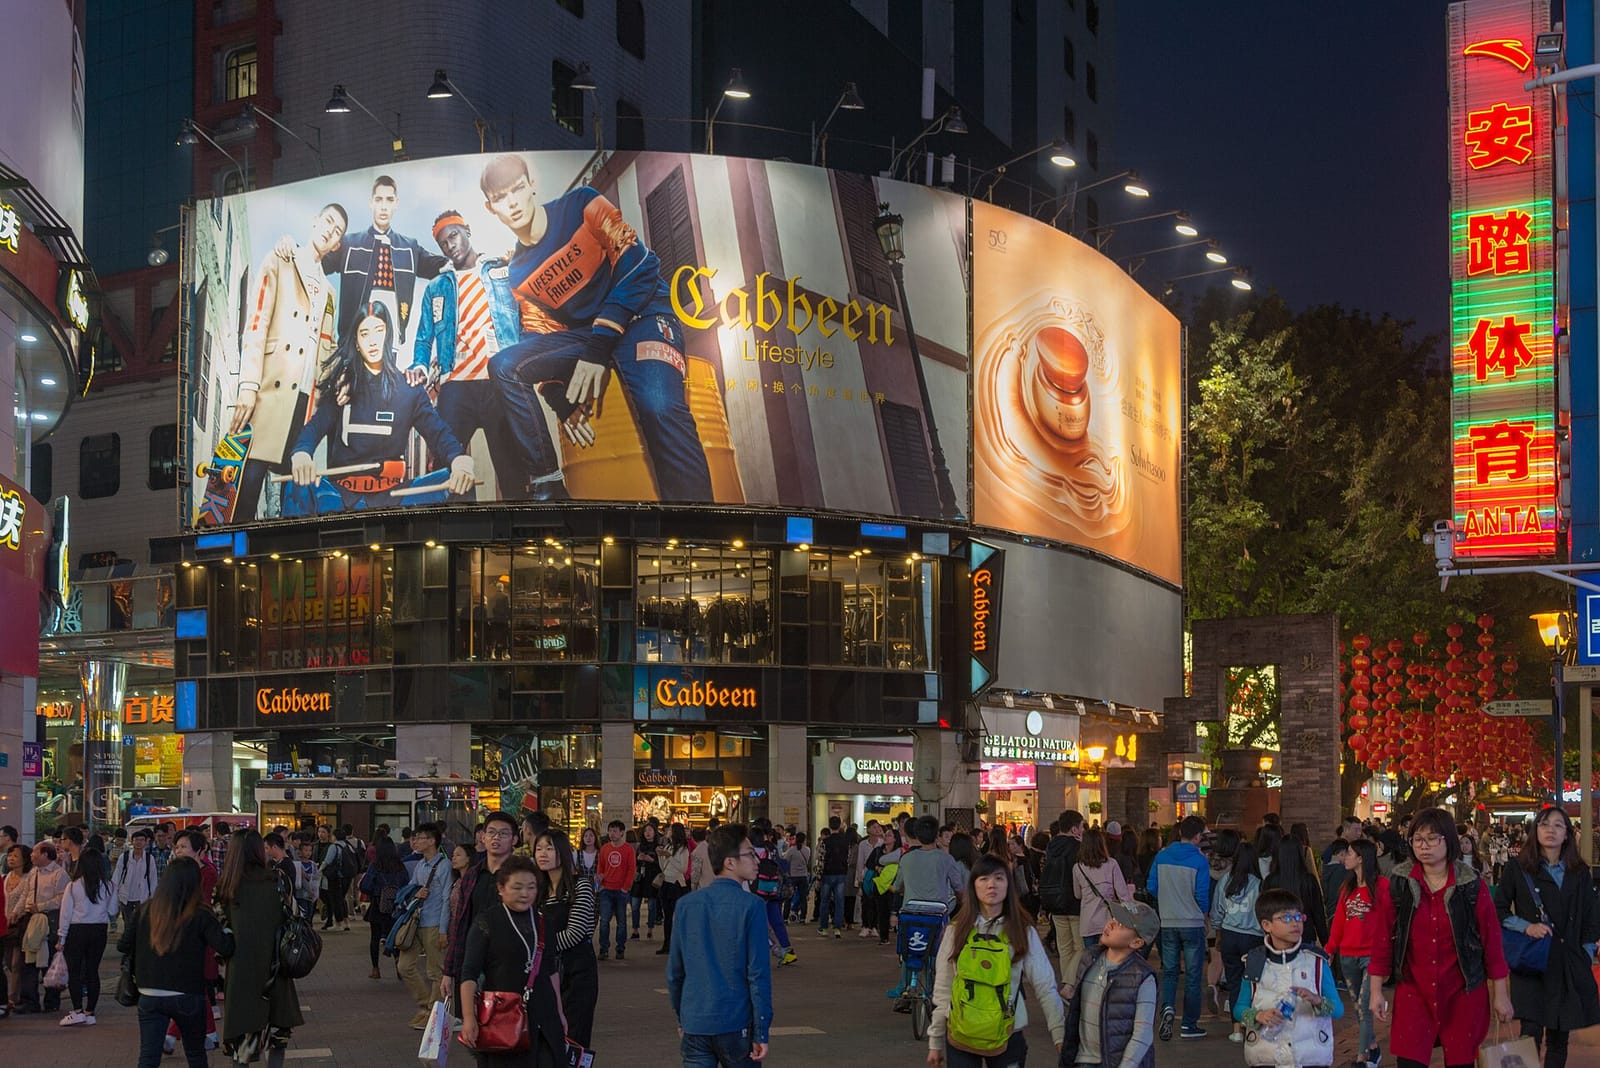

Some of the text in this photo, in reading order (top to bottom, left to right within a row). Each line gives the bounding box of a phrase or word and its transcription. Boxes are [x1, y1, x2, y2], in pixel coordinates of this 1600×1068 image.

[545, 267, 584, 305] FRIEND
[1464, 103, 1536, 486] 安踏体育
[670, 265, 895, 346] Cabbeen
[742, 340, 835, 371] Lifestyle
[1464, 505, 1542, 538] ANTA
[973, 569, 992, 651] Cabbeen
[256, 687, 332, 715] Cabbeen
[656, 679, 757, 707] Cabbeen
[985, 735, 1078, 753] GELATO DI NATURA
[639, 769, 678, 784] Cabbeen
[857, 759, 892, 772] GELATO
[892, 761, 903, 772] DI
